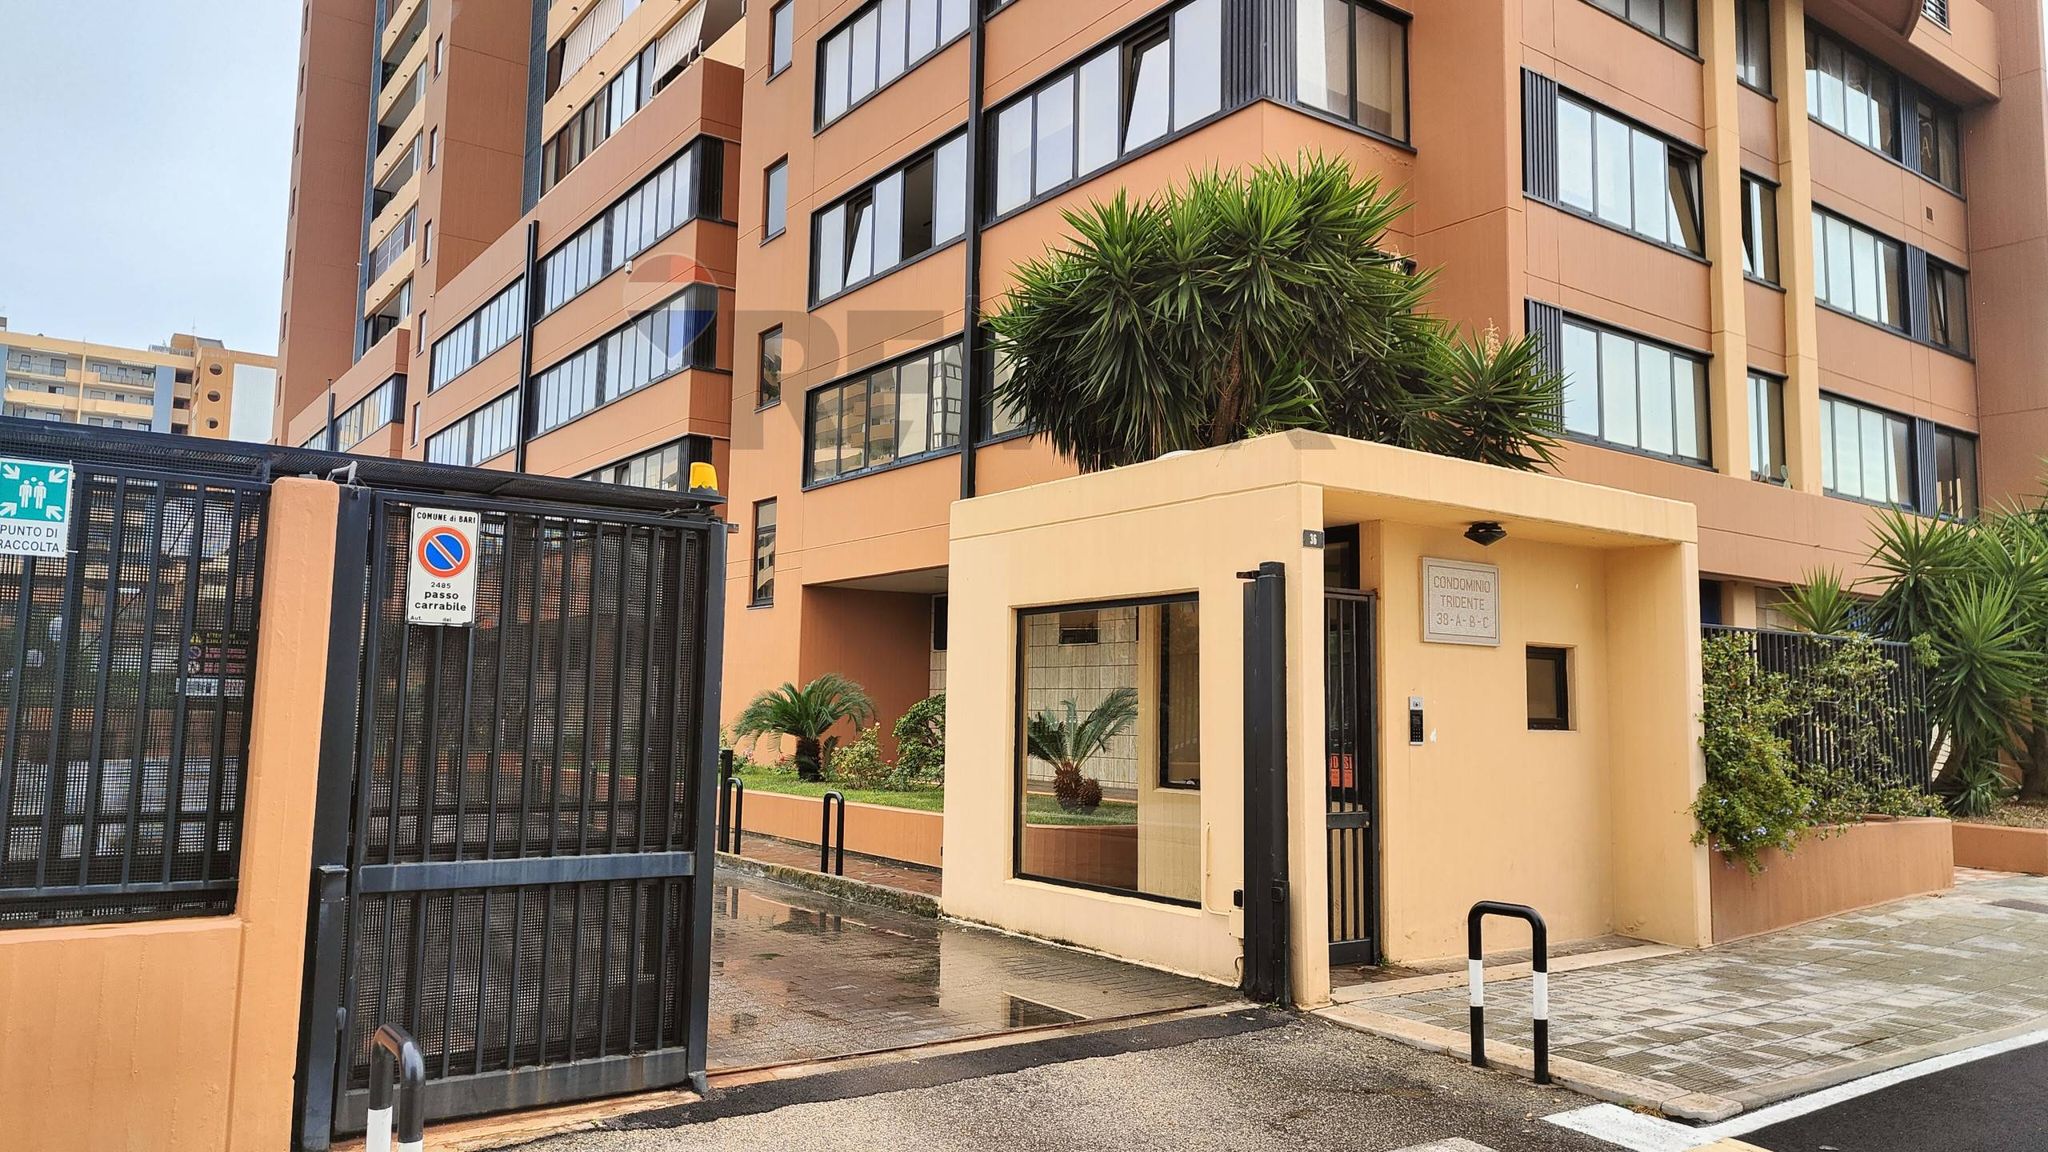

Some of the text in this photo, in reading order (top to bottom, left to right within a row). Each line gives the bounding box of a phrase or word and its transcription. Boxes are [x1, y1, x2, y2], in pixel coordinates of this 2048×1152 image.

[416, 511, 447, 522] COMUNE
[459, 515, 476, 524] BARI
[0, 525, 58, 538] PUNTO DI
[430, 581, 451, 589] 2485
[1433, 575, 1491, 593] CONDOMINIO
[424, 591, 459, 600] passo
[415, 602, 467, 611] carrabile
[1440, 594, 1485, 611] TRIDENTE
